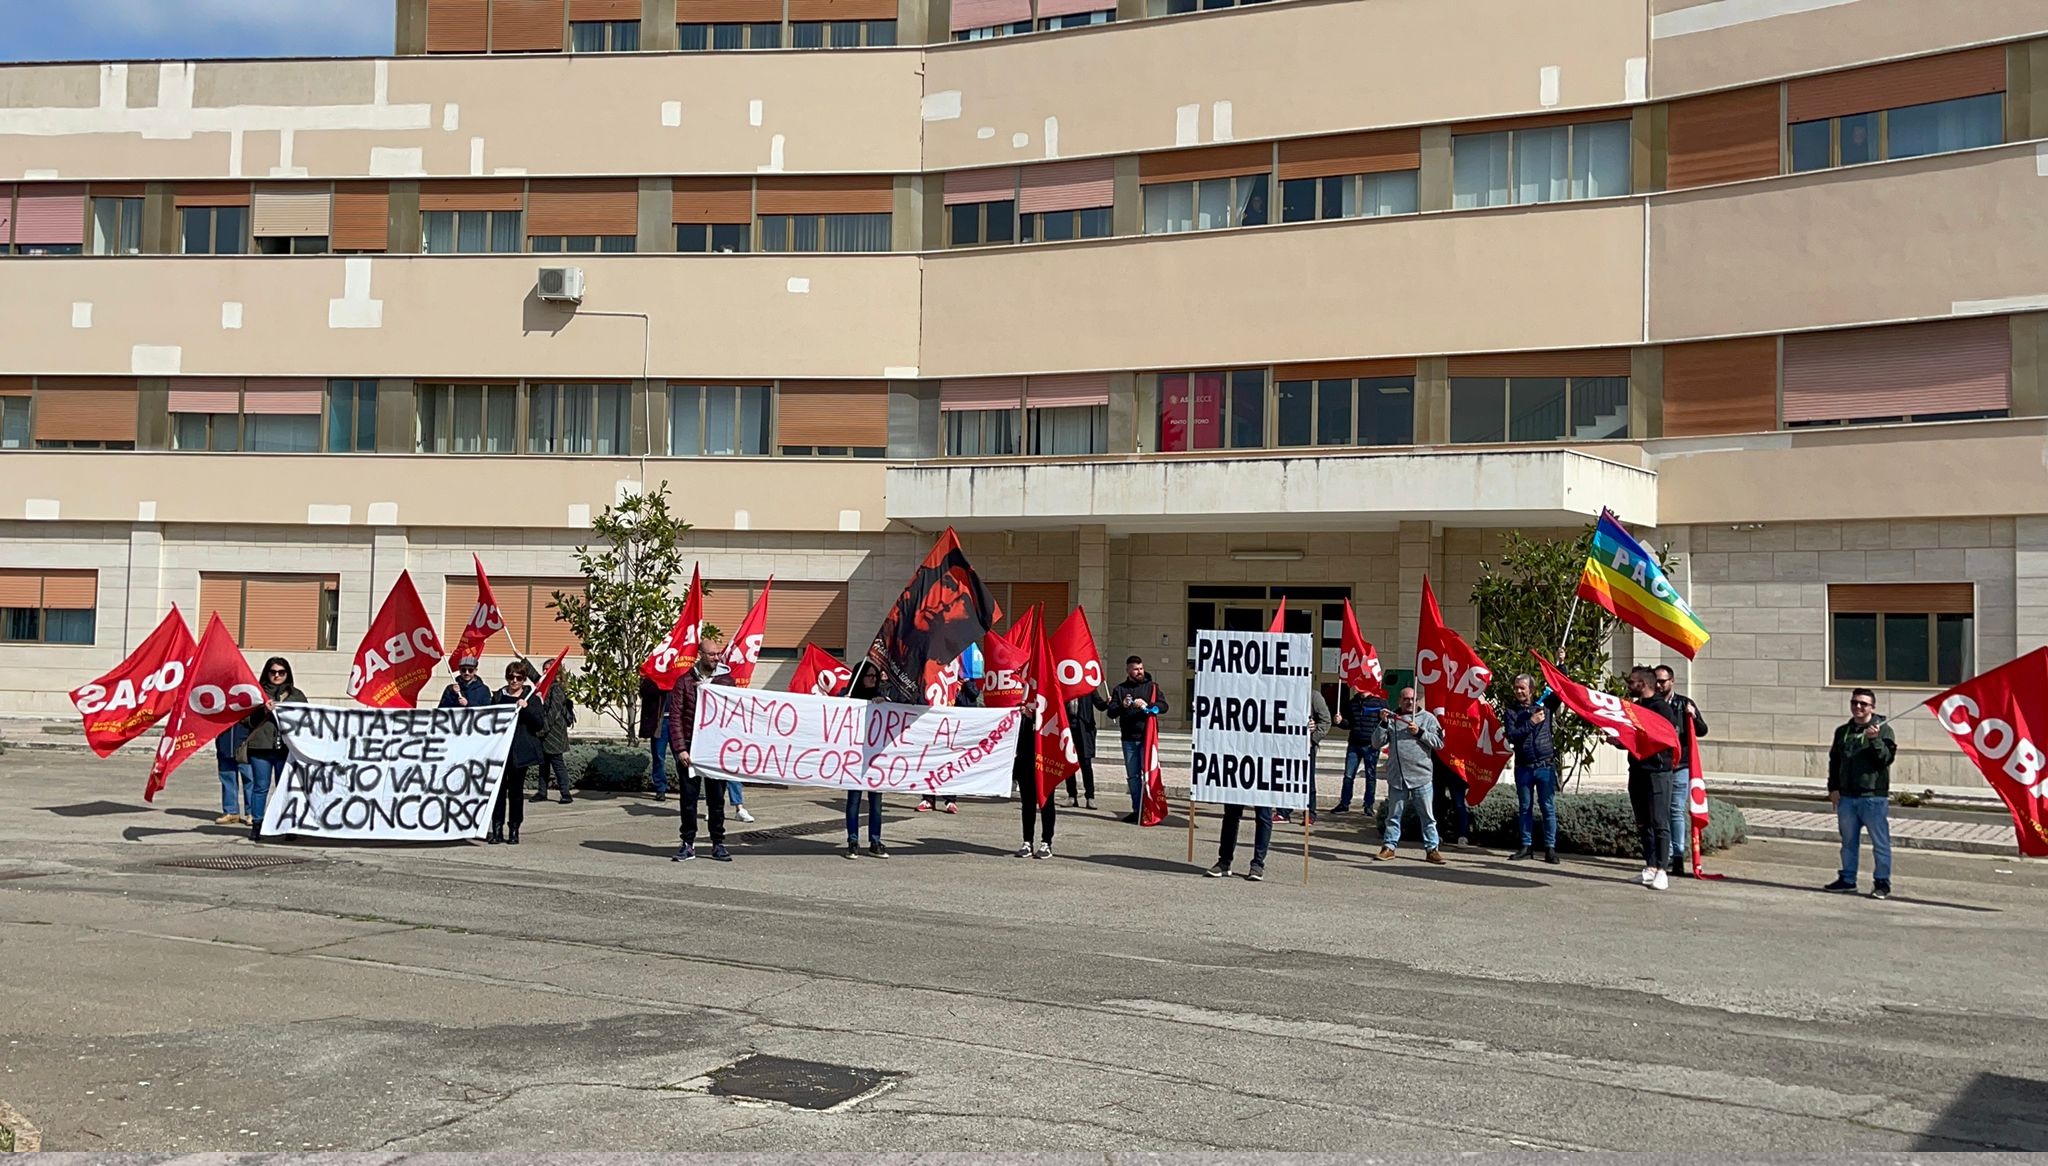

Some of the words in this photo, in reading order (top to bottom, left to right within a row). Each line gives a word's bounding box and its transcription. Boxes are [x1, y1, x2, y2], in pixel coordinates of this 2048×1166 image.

[1197, 638, 1309, 677] PAROLE...
[699, 689, 798, 736] DIAMO
[823, 704, 918, 748] VALORE
[934, 717, 967, 752] AL
[1195, 696, 1308, 736] PAROLE...
[348, 737, 449, 762] LECCE
[719, 737, 929, 789] CONCORSO!
[389, 758, 505, 797] VALORE
[1192, 752, 1308, 794] PAROLE!!!
[276, 796, 319, 831] AL
